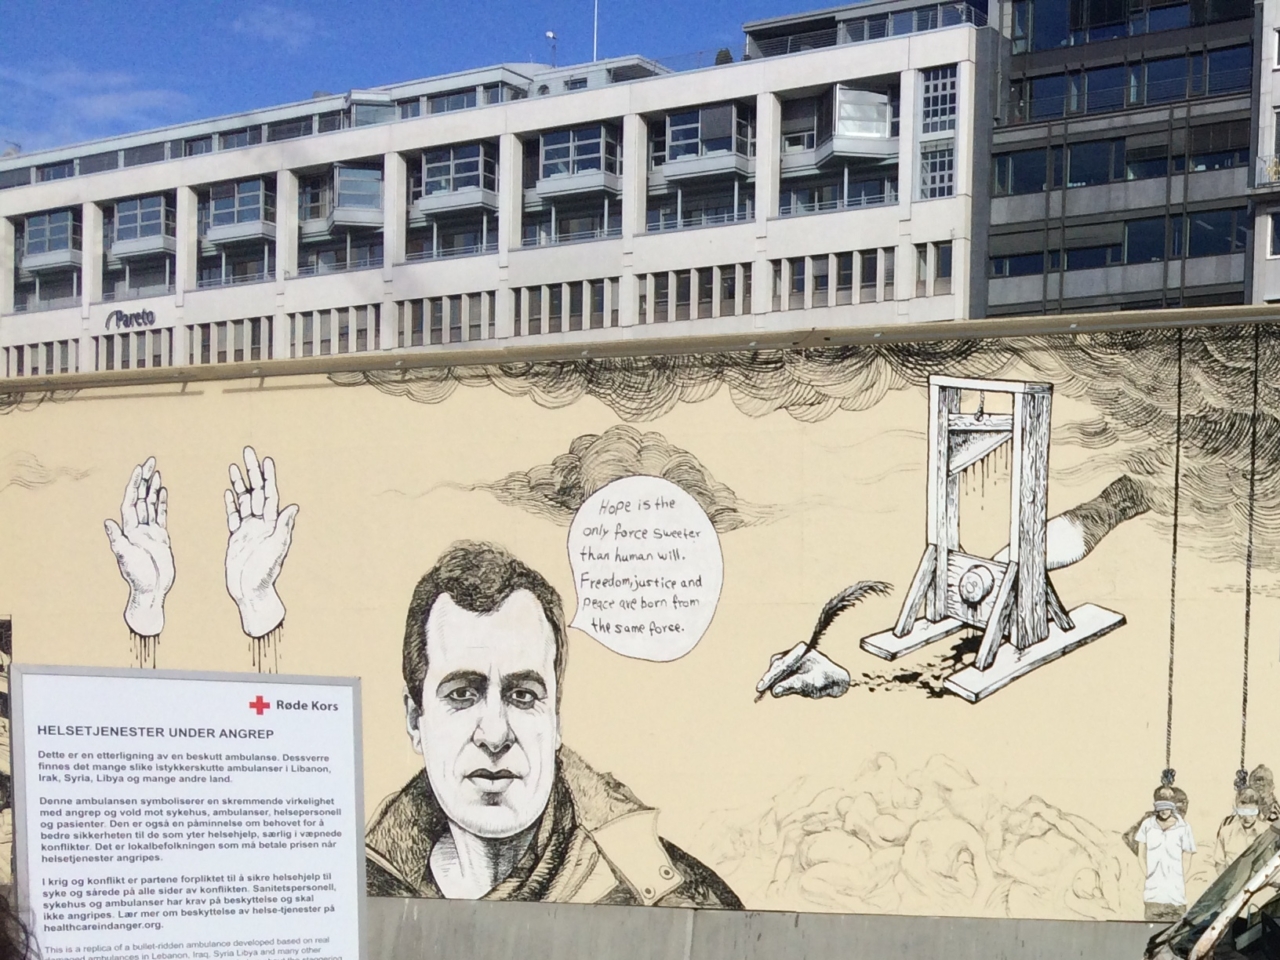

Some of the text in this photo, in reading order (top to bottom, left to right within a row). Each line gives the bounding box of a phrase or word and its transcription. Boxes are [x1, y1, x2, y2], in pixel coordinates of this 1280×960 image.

[110, 308, 156, 329] Pareto
[599, 496, 676, 515] Hope is the
[582, 524, 609, 540] only
[614, 522, 648, 540] force
[580, 546, 686, 562] than human will.
[680, 574, 702, 588] and
[619, 598, 637, 610] are
[641, 596, 667, 608] born
[672, 594, 700, 609] from
[591, 618, 684, 636] the same force.
[276, 699, 338, 711] Røde Kors
[37, 725, 274, 739] HELSETJENESTER UNDER ANGREP
[37, 750, 65, 759] Dette
[97, 751, 154, 761] etterligning
[186, 752, 222, 760] beskutt
[225, 753, 280, 761] ambulanse.
[282, 753, 330, 762] Dessverre
[38, 762, 70, 770] finnes
[73, 762, 90, 770] det
[92, 764, 127, 772] mange
[129, 763, 153, 771] slike
[155, 763, 224, 772] istykkerskutte
[291, 764, 331, 773] Libanon,
[38, 773, 61, 783] Irak,
[64, 773, 93, 784] Syria,
[96, 774, 124, 784] Libya
[127, 776, 140, 784] og
[142, 776, 176, 784] mange
[39, 796, 73, 805] Denne
[140, 797, 204, 806] symboliserer
[286, 797, 335, 806] virkelighet
[40, 808, 63, 816] med
[65, 810, 101, 818] angrep
[104, 810, 117, 818] og
[120, 808, 142, 816] vold
[166, 808, 210, 817] sykehus,
[212, 808, 271, 816] ambulanser,
[274, 808, 342, 816] helsepersonell
[40, 822, 54, 830] og
[56, 820, 106, 829] pasienter.
[109, 819, 130, 828] Den
[145, 820, 170, 829] også
[187, 819, 243, 828] påminnelse
[303, 818, 316, 827] for
[319, 818, 324, 826] å
[40, 831, 70, 840] bedre
[73, 831, 133, 840] sikkerheten
[135, 830, 145, 839] til
[147, 830, 160, 839] de
[186, 831, 205, 840] yter
[208, 830, 259, 840] helsehjelp,
[262, 830, 292, 839] særlig
[41, 842, 91, 851] konflikter.
[95, 842, 113, 851] Det
[128, 841, 216, 851] lokalbefolkningen
[241, 841, 256, 849] må
[259, 841, 288, 849] betale
[41, 854, 162, 863] helsetjenester angripes.
[43, 912, 65, 920] ikke
[118, 910, 138, 918] Lær
[180, 907, 236, 917] beskyttelse
[252, 905, 321, 914] helse-tjenester
[324, 904, 335, 914] på
